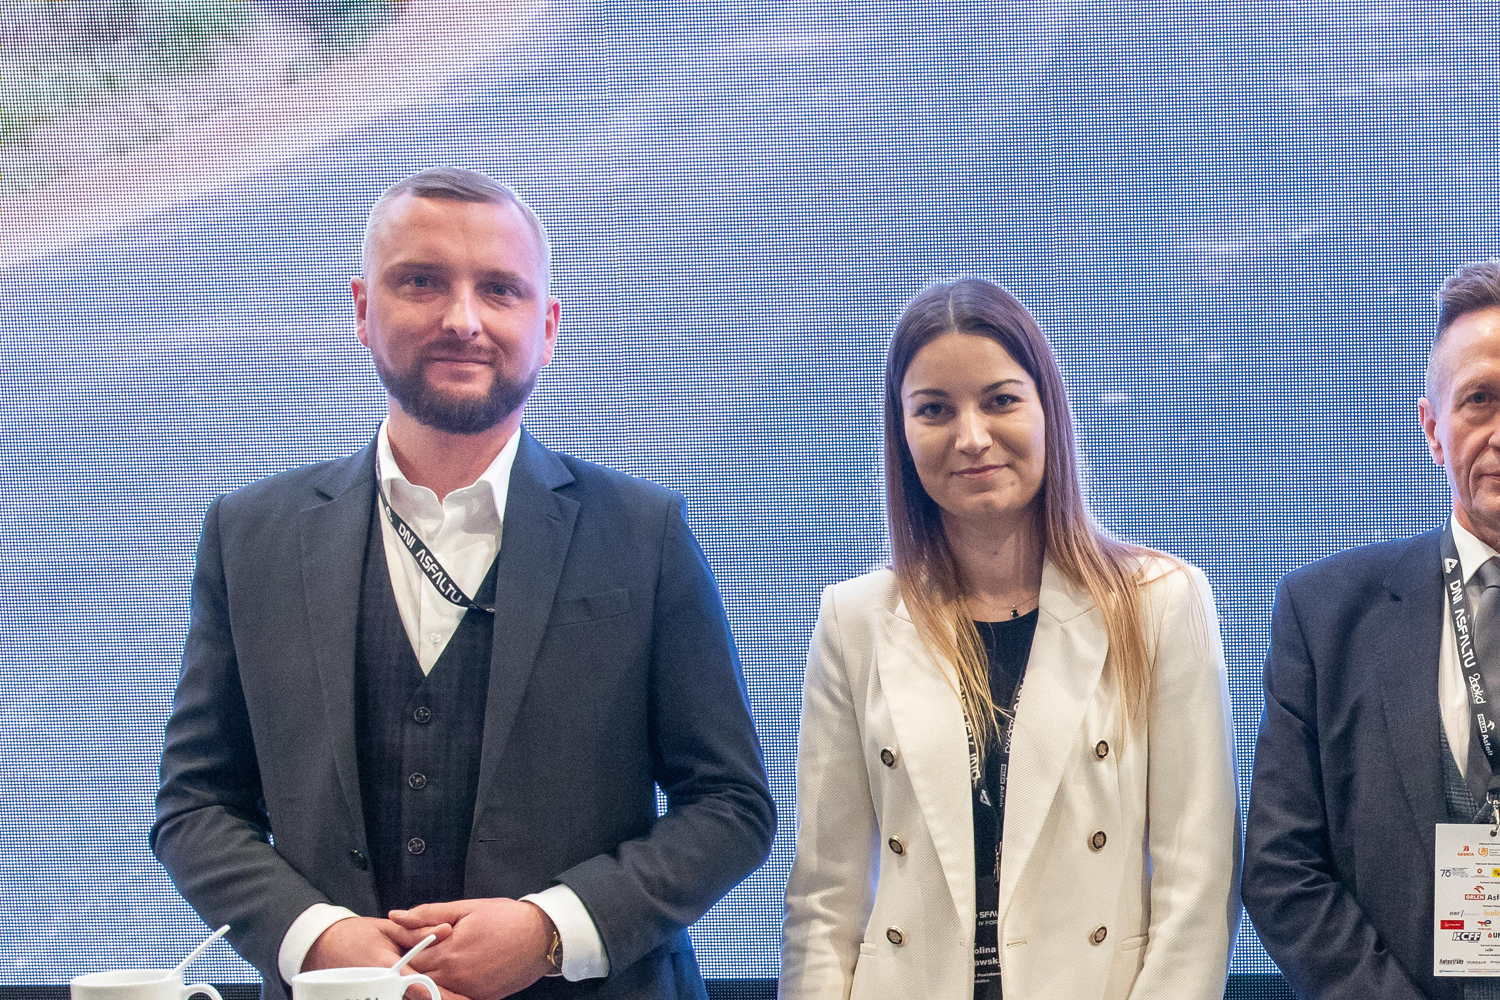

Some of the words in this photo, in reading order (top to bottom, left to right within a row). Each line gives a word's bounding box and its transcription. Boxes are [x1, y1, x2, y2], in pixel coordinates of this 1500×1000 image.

[398, 523, 416, 548] DNI
[415, 549, 462, 603] ASFALTU
[1450, 579, 1462, 605] DNI
[1454, 608, 1476, 669] ASFALTU
[975, 946, 997, 954] olina
